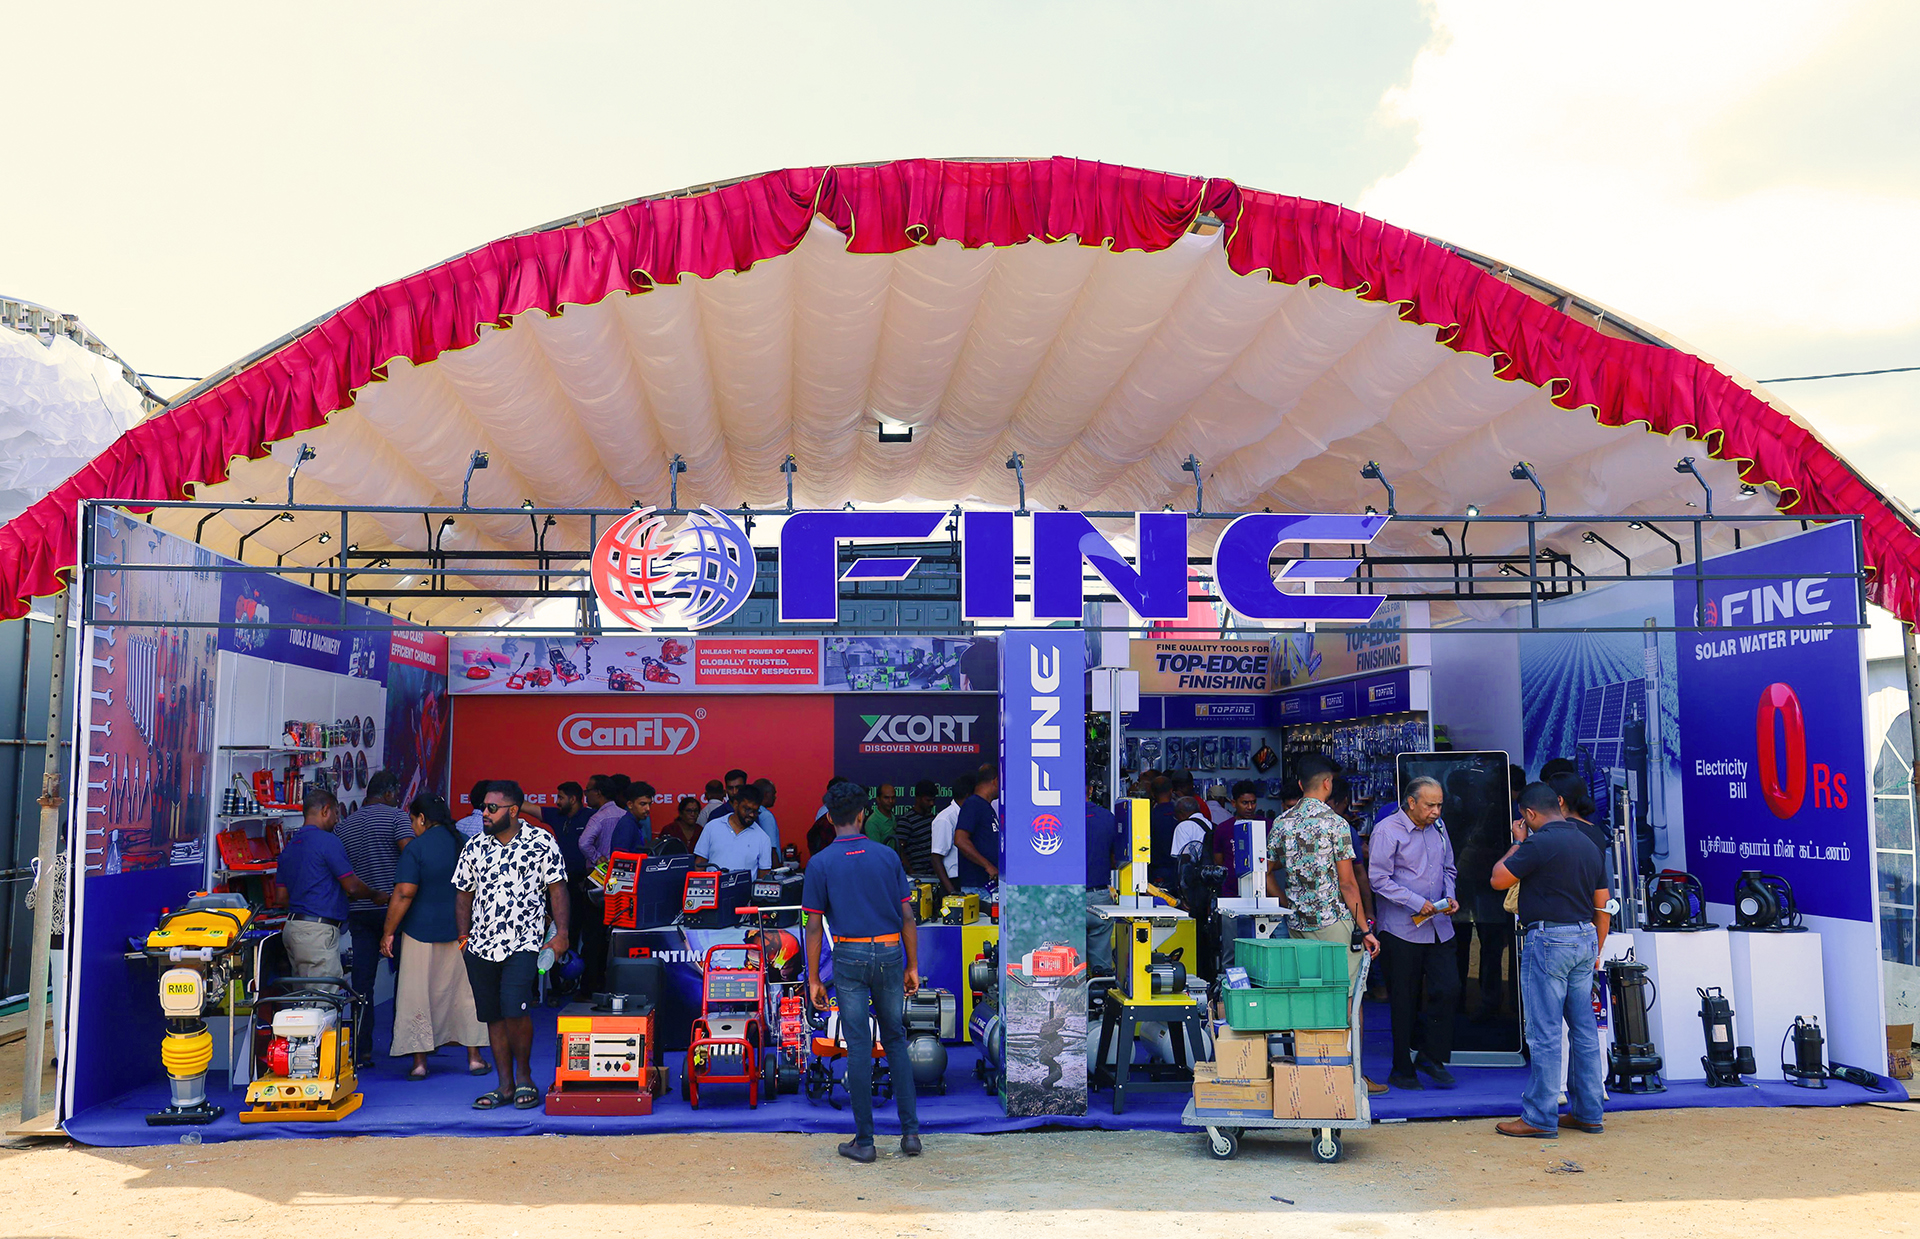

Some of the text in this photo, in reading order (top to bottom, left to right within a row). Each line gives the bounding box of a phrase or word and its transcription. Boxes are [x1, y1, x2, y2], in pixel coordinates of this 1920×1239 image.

[779, 511, 1392, 622] FINE
[1721, 571, 1832, 627] FINE
[289, 628, 307, 647] TOOLS
[311, 633, 342, 656] MACHINERY
[1345, 614, 1400, 653] TOP-EDGE
[1695, 621, 1834, 661] SOLAR WATER PUMP
[391, 642, 415, 660] EFFICIENT
[1156, 643, 1270, 653] FINE QUALITY TOOLS FOR
[1356, 645, 1400, 671] FINISHING
[700, 658, 789, 667] GLOBALLY TRUSTED,
[700, 667, 814, 675] UNIVERSALLY RESPECTED.
[1155, 653, 1269, 674] TOP-EDGE
[1178, 674, 1267, 690] FINISHING
[859, 714, 979, 742] XCORT
[1030, 643, 1061, 806] FINE
[569, 718, 689, 755] CanFly
[864, 744, 974, 753] DISCOVER YOUR POWER
[1756, 682, 1848, 820] 0 Rs
[1695, 758, 1748, 780] Electricity
[1729, 781, 1747, 799] Bill
[1773, 838, 1796, 858] மின்
[1798, 839, 1851, 861] கட்டணம்
[168, 983, 194, 993] RM80
